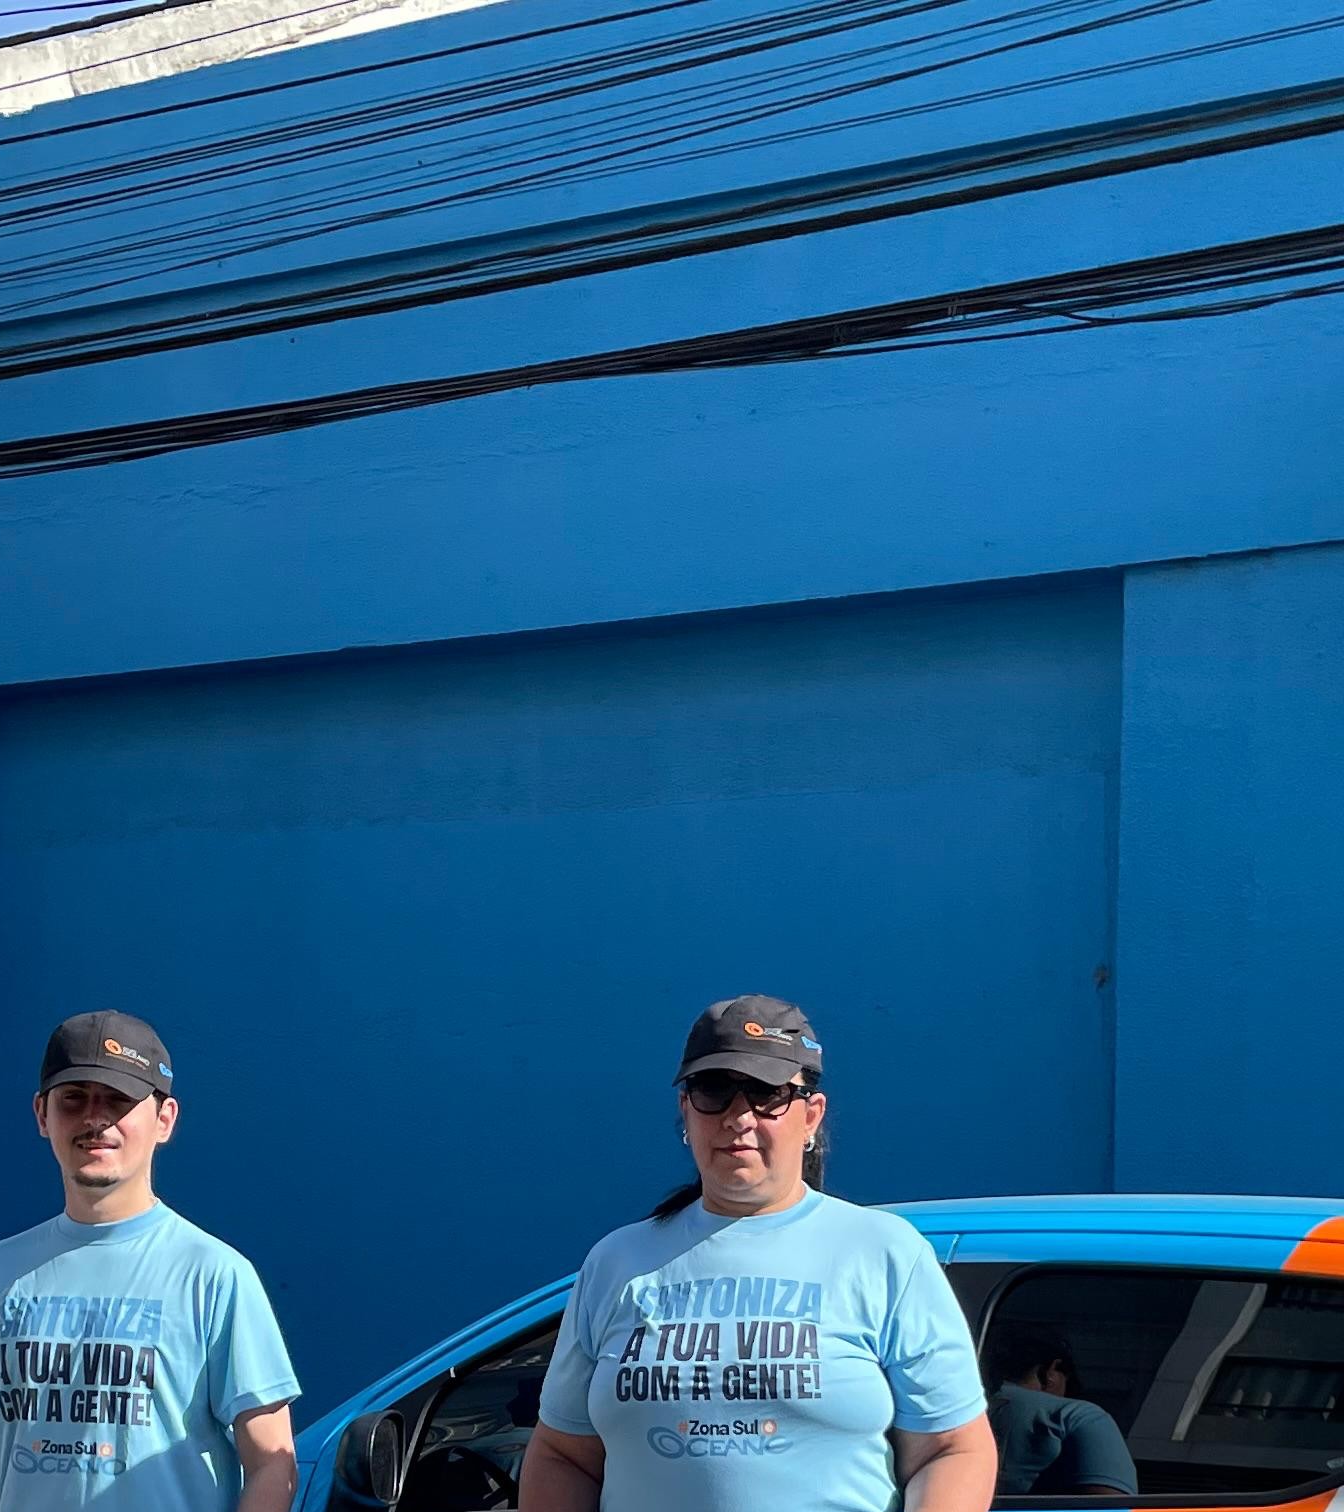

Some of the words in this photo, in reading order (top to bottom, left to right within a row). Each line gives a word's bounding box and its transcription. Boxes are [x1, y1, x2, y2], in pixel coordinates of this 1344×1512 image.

[619, 1325, 647, 1364] A
[655, 1322, 720, 1361] TUA
[736, 1320, 820, 1360] VIDA
[15, 1342, 71, 1385] TUA
[82, 1343, 156, 1389] VIDA
[616, 1365, 679, 1402] COM
[691, 1366, 711, 1401] A
[722, 1363, 822, 1400] GENTE!
[45, 1389, 62, 1423] A
[70, 1390, 152, 1426] GENTE!
[732, 1419, 759, 1436] Sul
[75, 1440, 97, 1455] Sul
